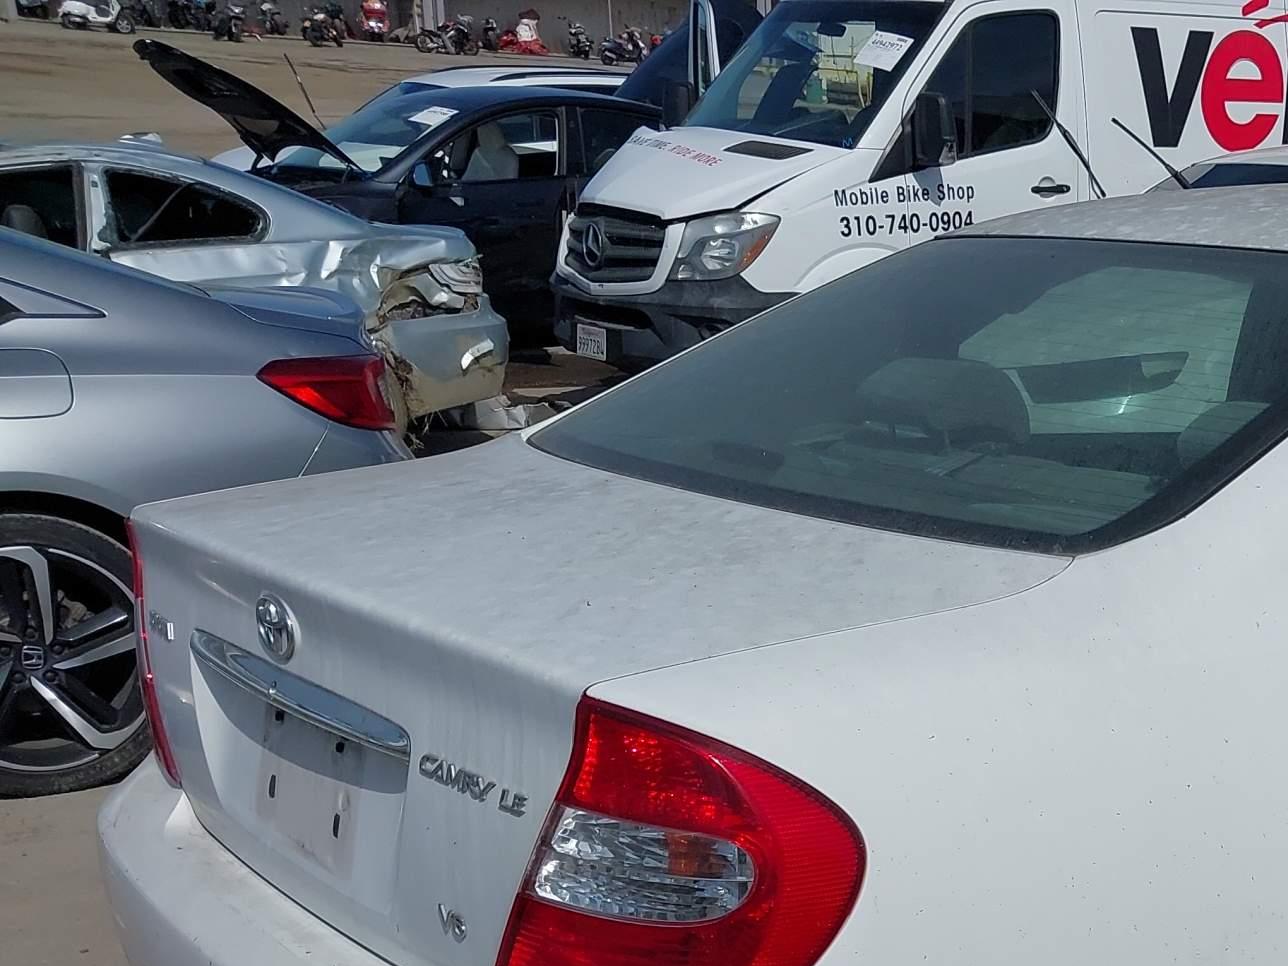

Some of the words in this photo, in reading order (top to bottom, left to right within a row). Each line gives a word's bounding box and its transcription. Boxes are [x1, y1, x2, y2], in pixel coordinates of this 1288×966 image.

[690, 152, 723, 167] MORE
[833, 187, 889, 208] Mobile
[896, 185, 930, 203] Bike
[936, 183, 975, 203] Shop
[839, 210, 975, 238] 310-740-0904
[419, 752, 497, 803] CAMRY
[498, 788, 529, 818] LE
[438, 903, 467, 944] V6
